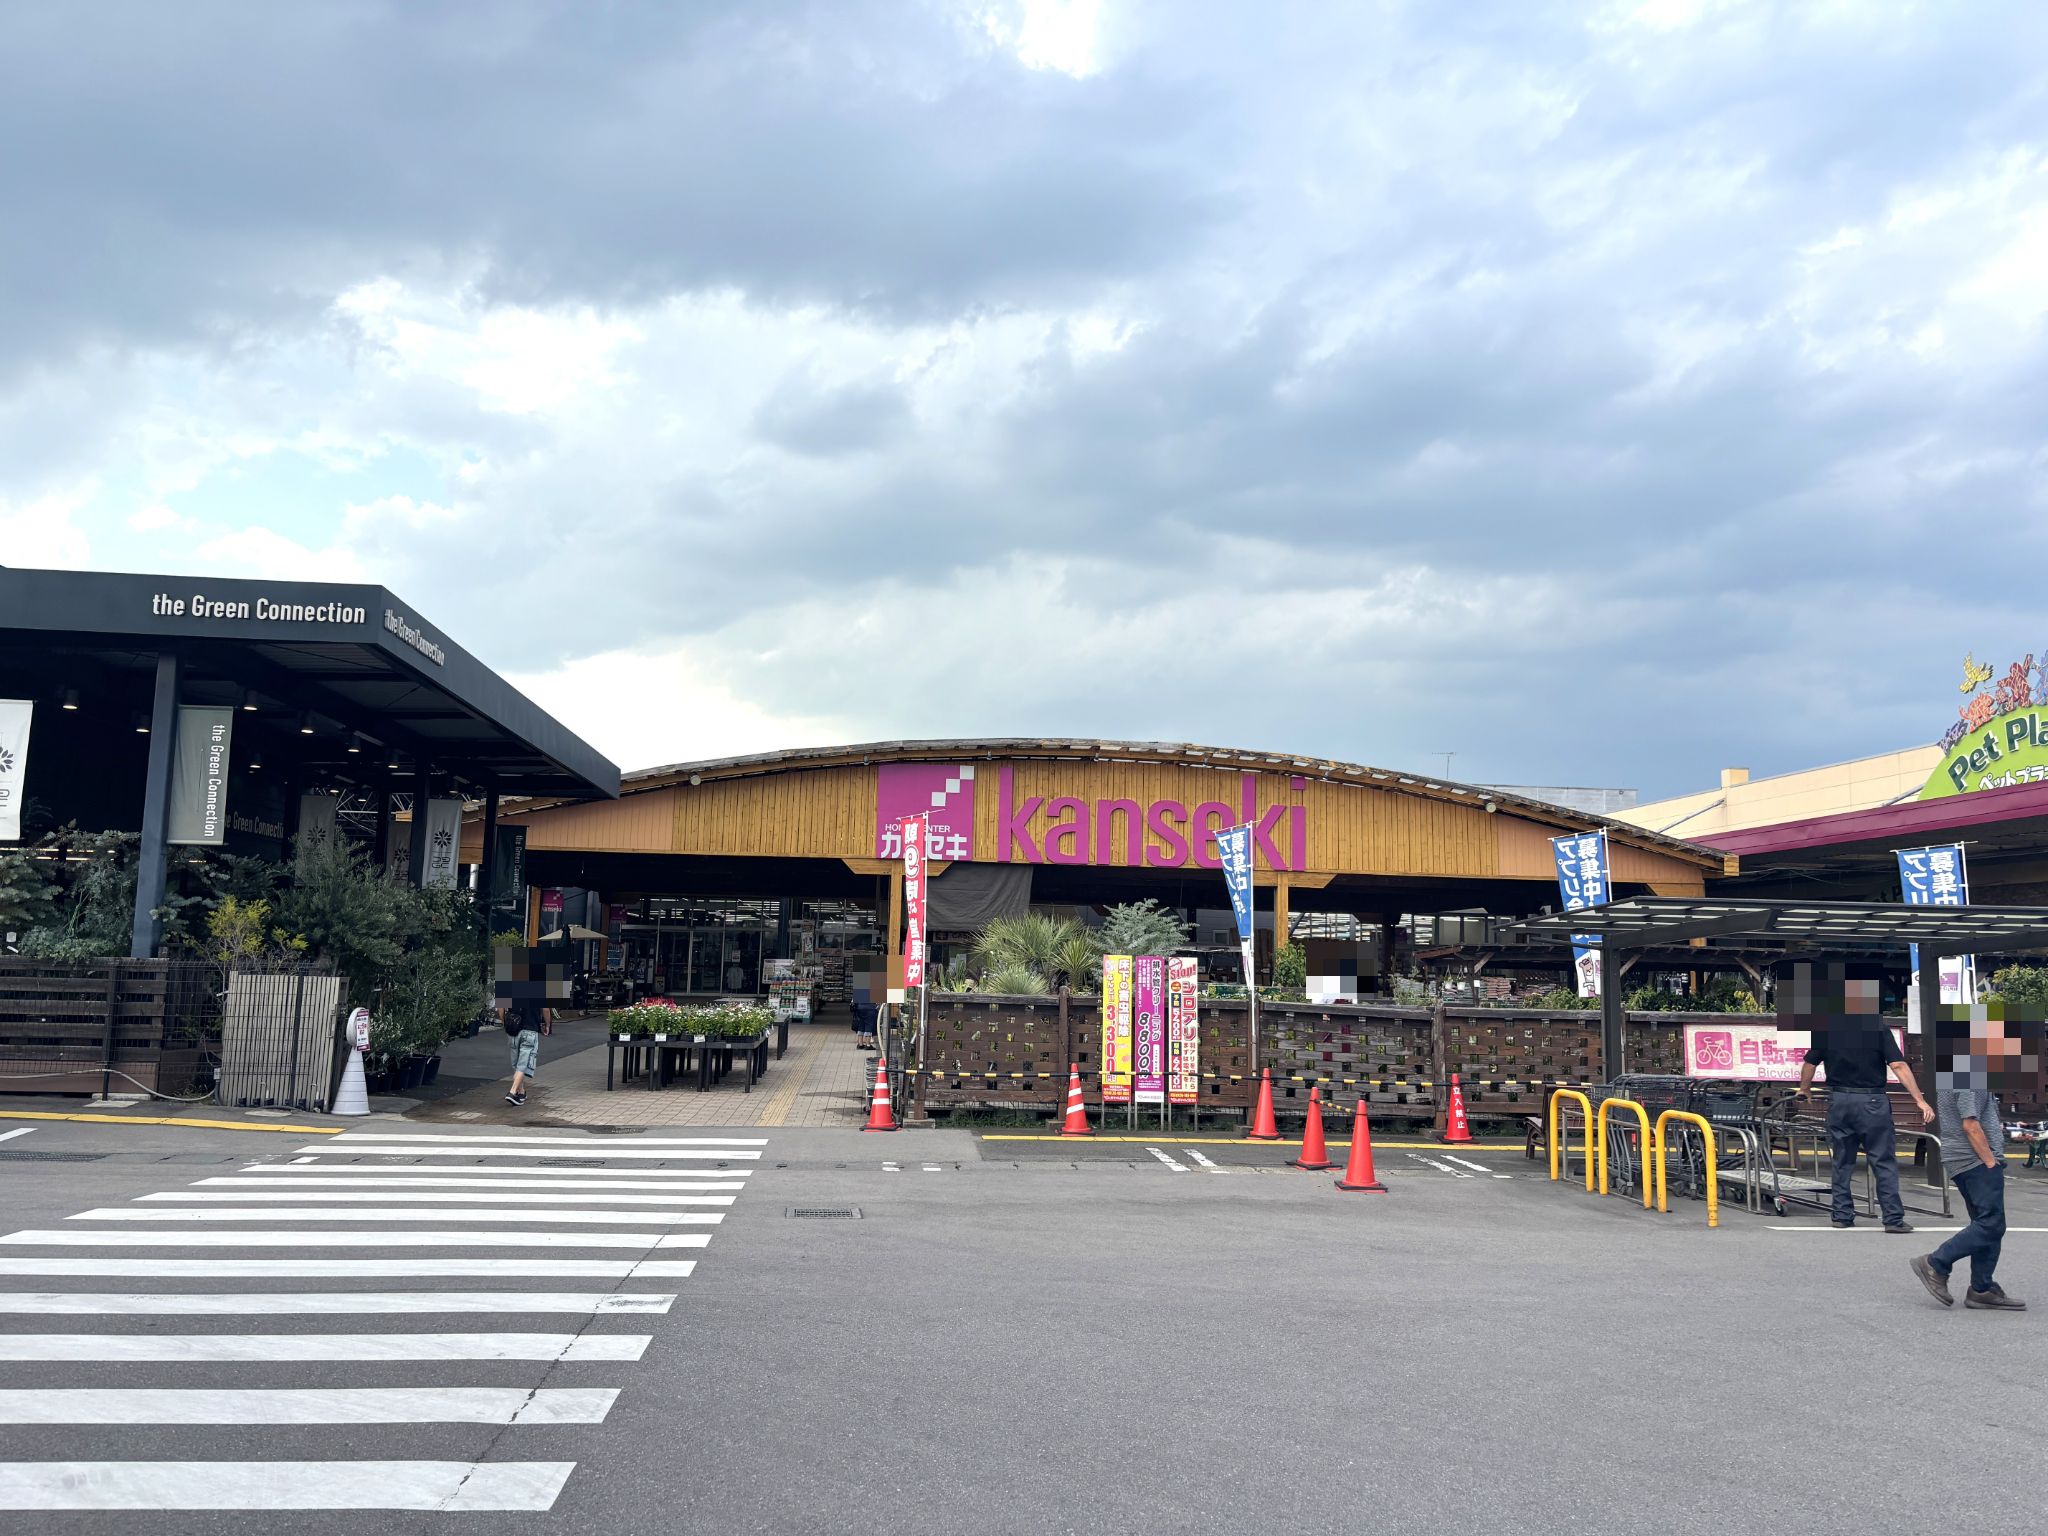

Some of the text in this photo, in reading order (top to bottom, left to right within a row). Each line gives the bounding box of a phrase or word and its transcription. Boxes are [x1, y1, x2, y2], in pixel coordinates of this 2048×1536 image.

[152, 593, 366, 624] the Green Connection
[204, 725, 225, 837] the Green Connection
[1948, 730, 2003, 793] Pet
[1979, 765, 2048, 790] ペットプラ
[998, 765, 1307, 872] kanseki
[880, 832, 968, 861] カセキ
[1182, 981, 1196, 1041] シロアリ
[1757, 1067, 1801, 1079] Bicycle
[1452, 1086, 1466, 1129] 立入禁止
